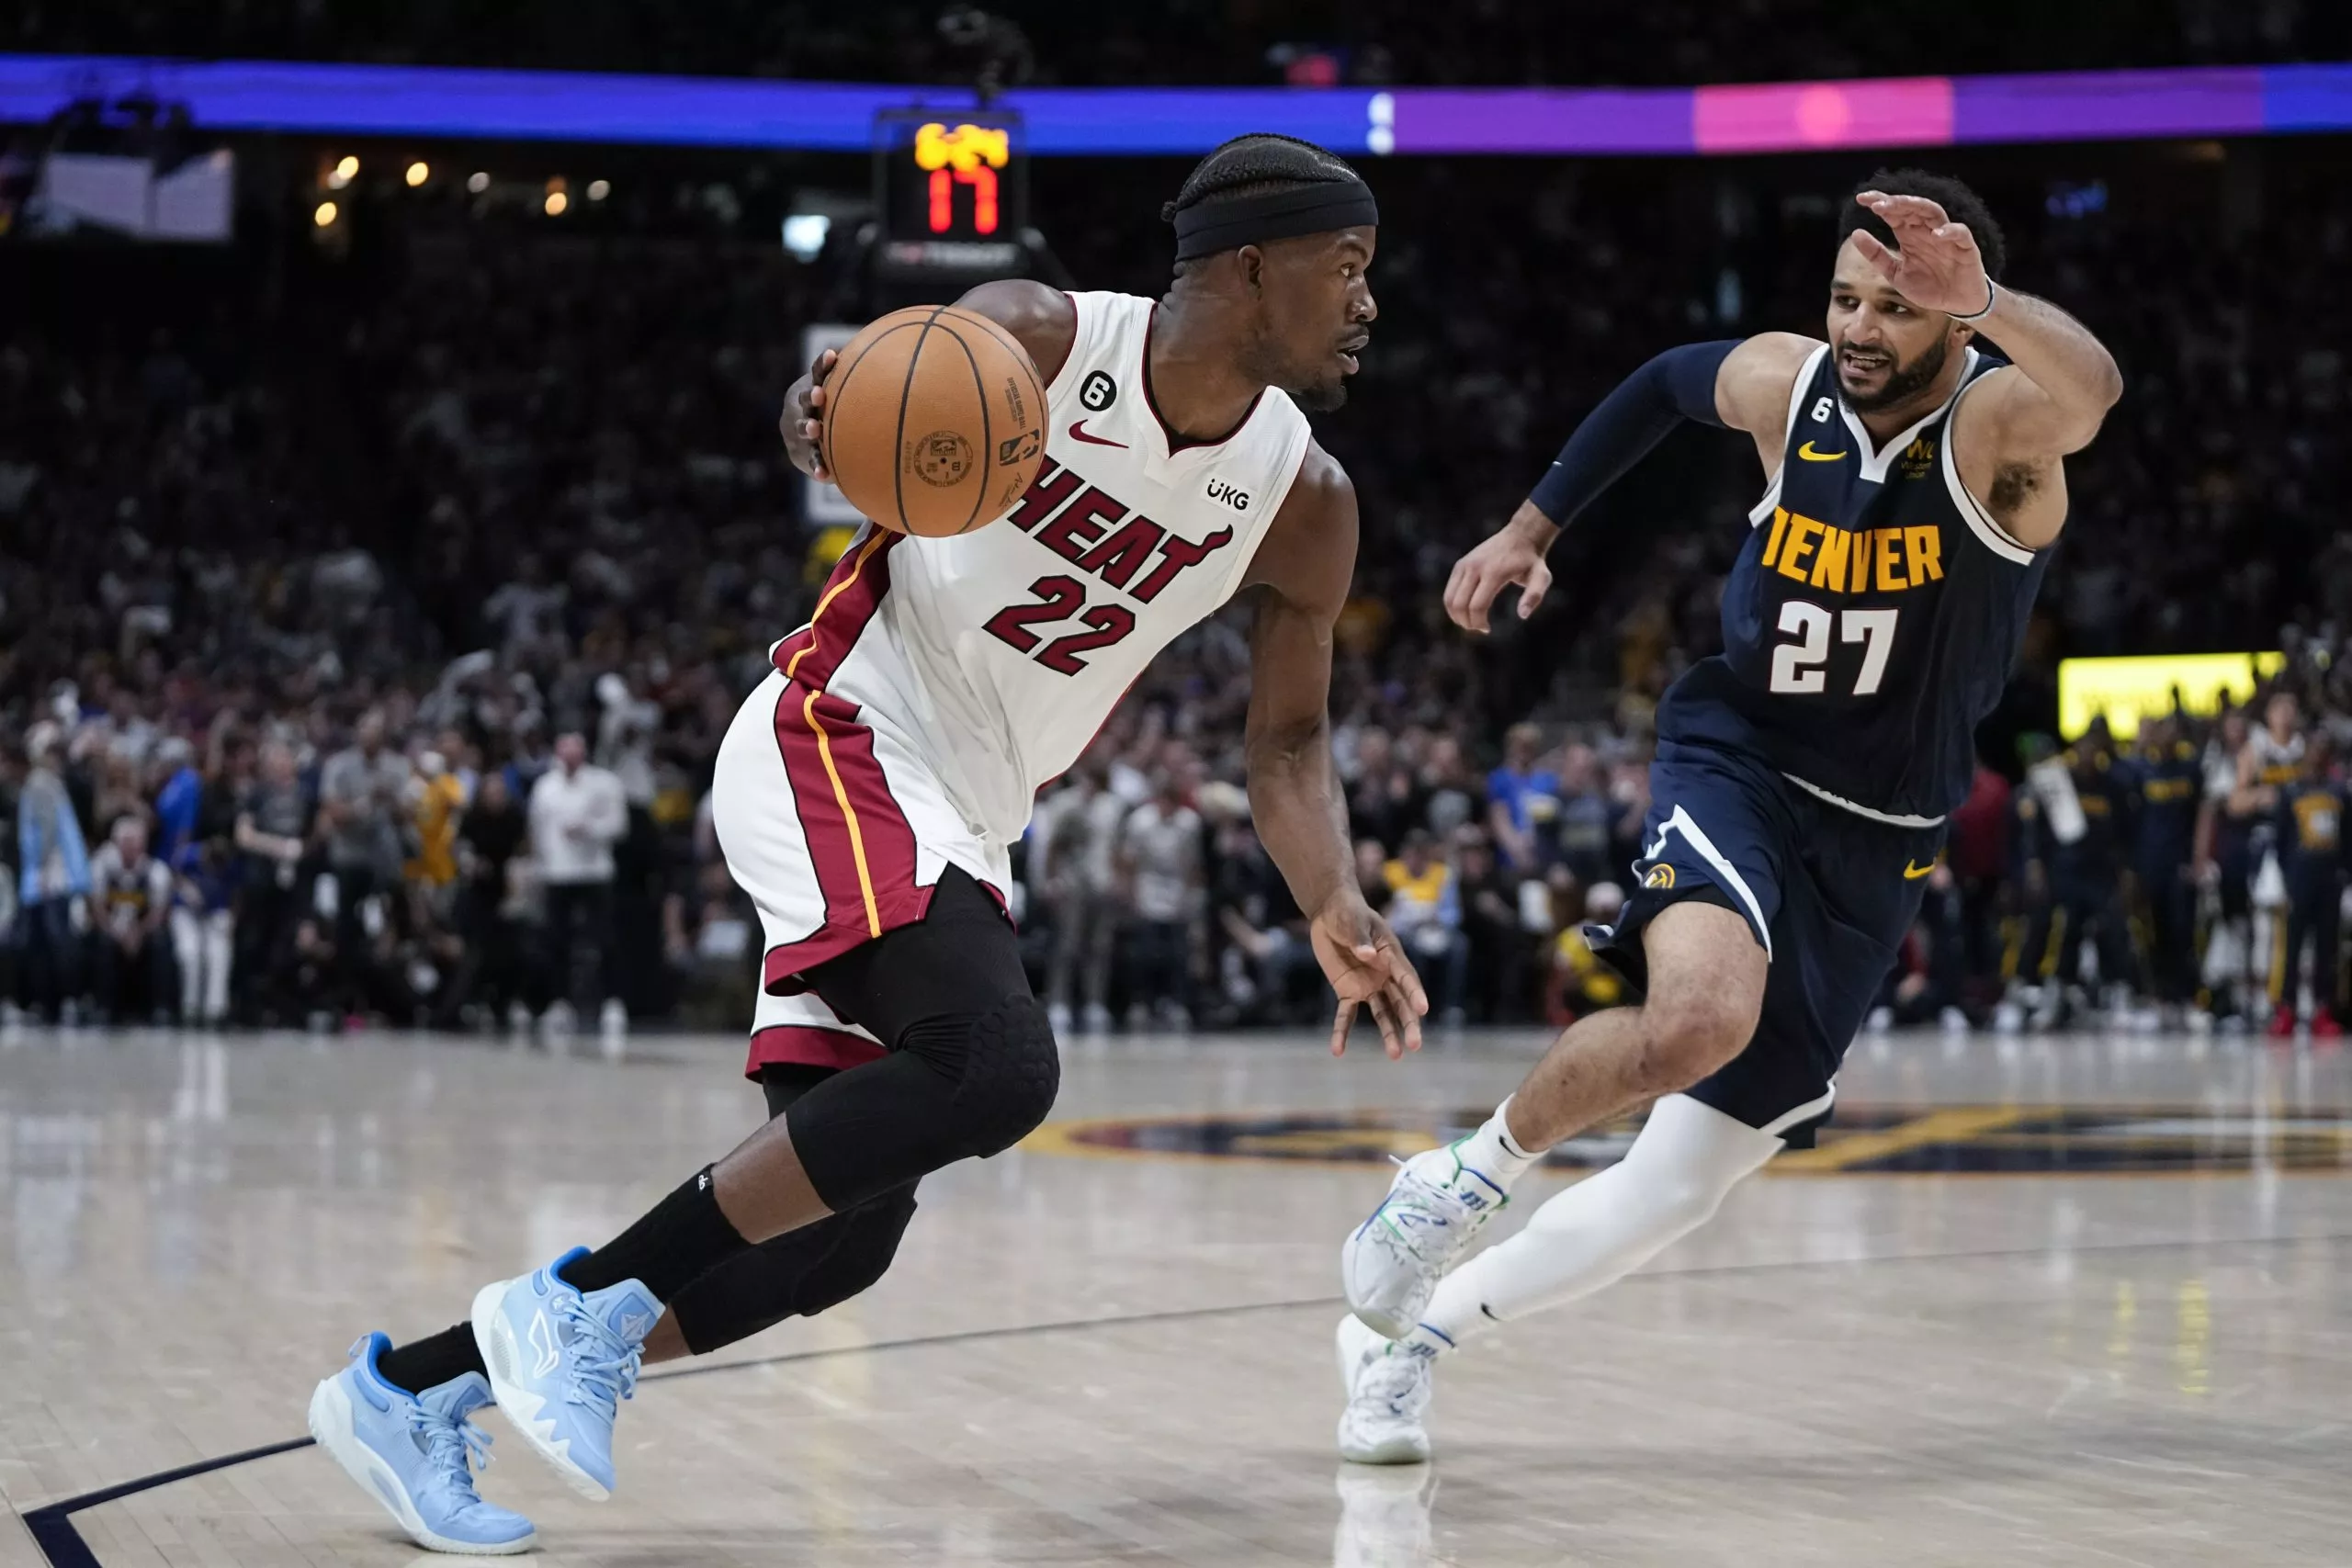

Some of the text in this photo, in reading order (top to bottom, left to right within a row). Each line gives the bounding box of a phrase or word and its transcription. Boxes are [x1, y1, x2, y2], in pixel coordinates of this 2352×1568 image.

[1084, 376, 1110, 407] 6
[1811, 396, 1833, 423] 6
[1006, 454, 1234, 605] HEAT
[981, 574, 1136, 678] 22
[1770, 600, 1900, 696] 27
